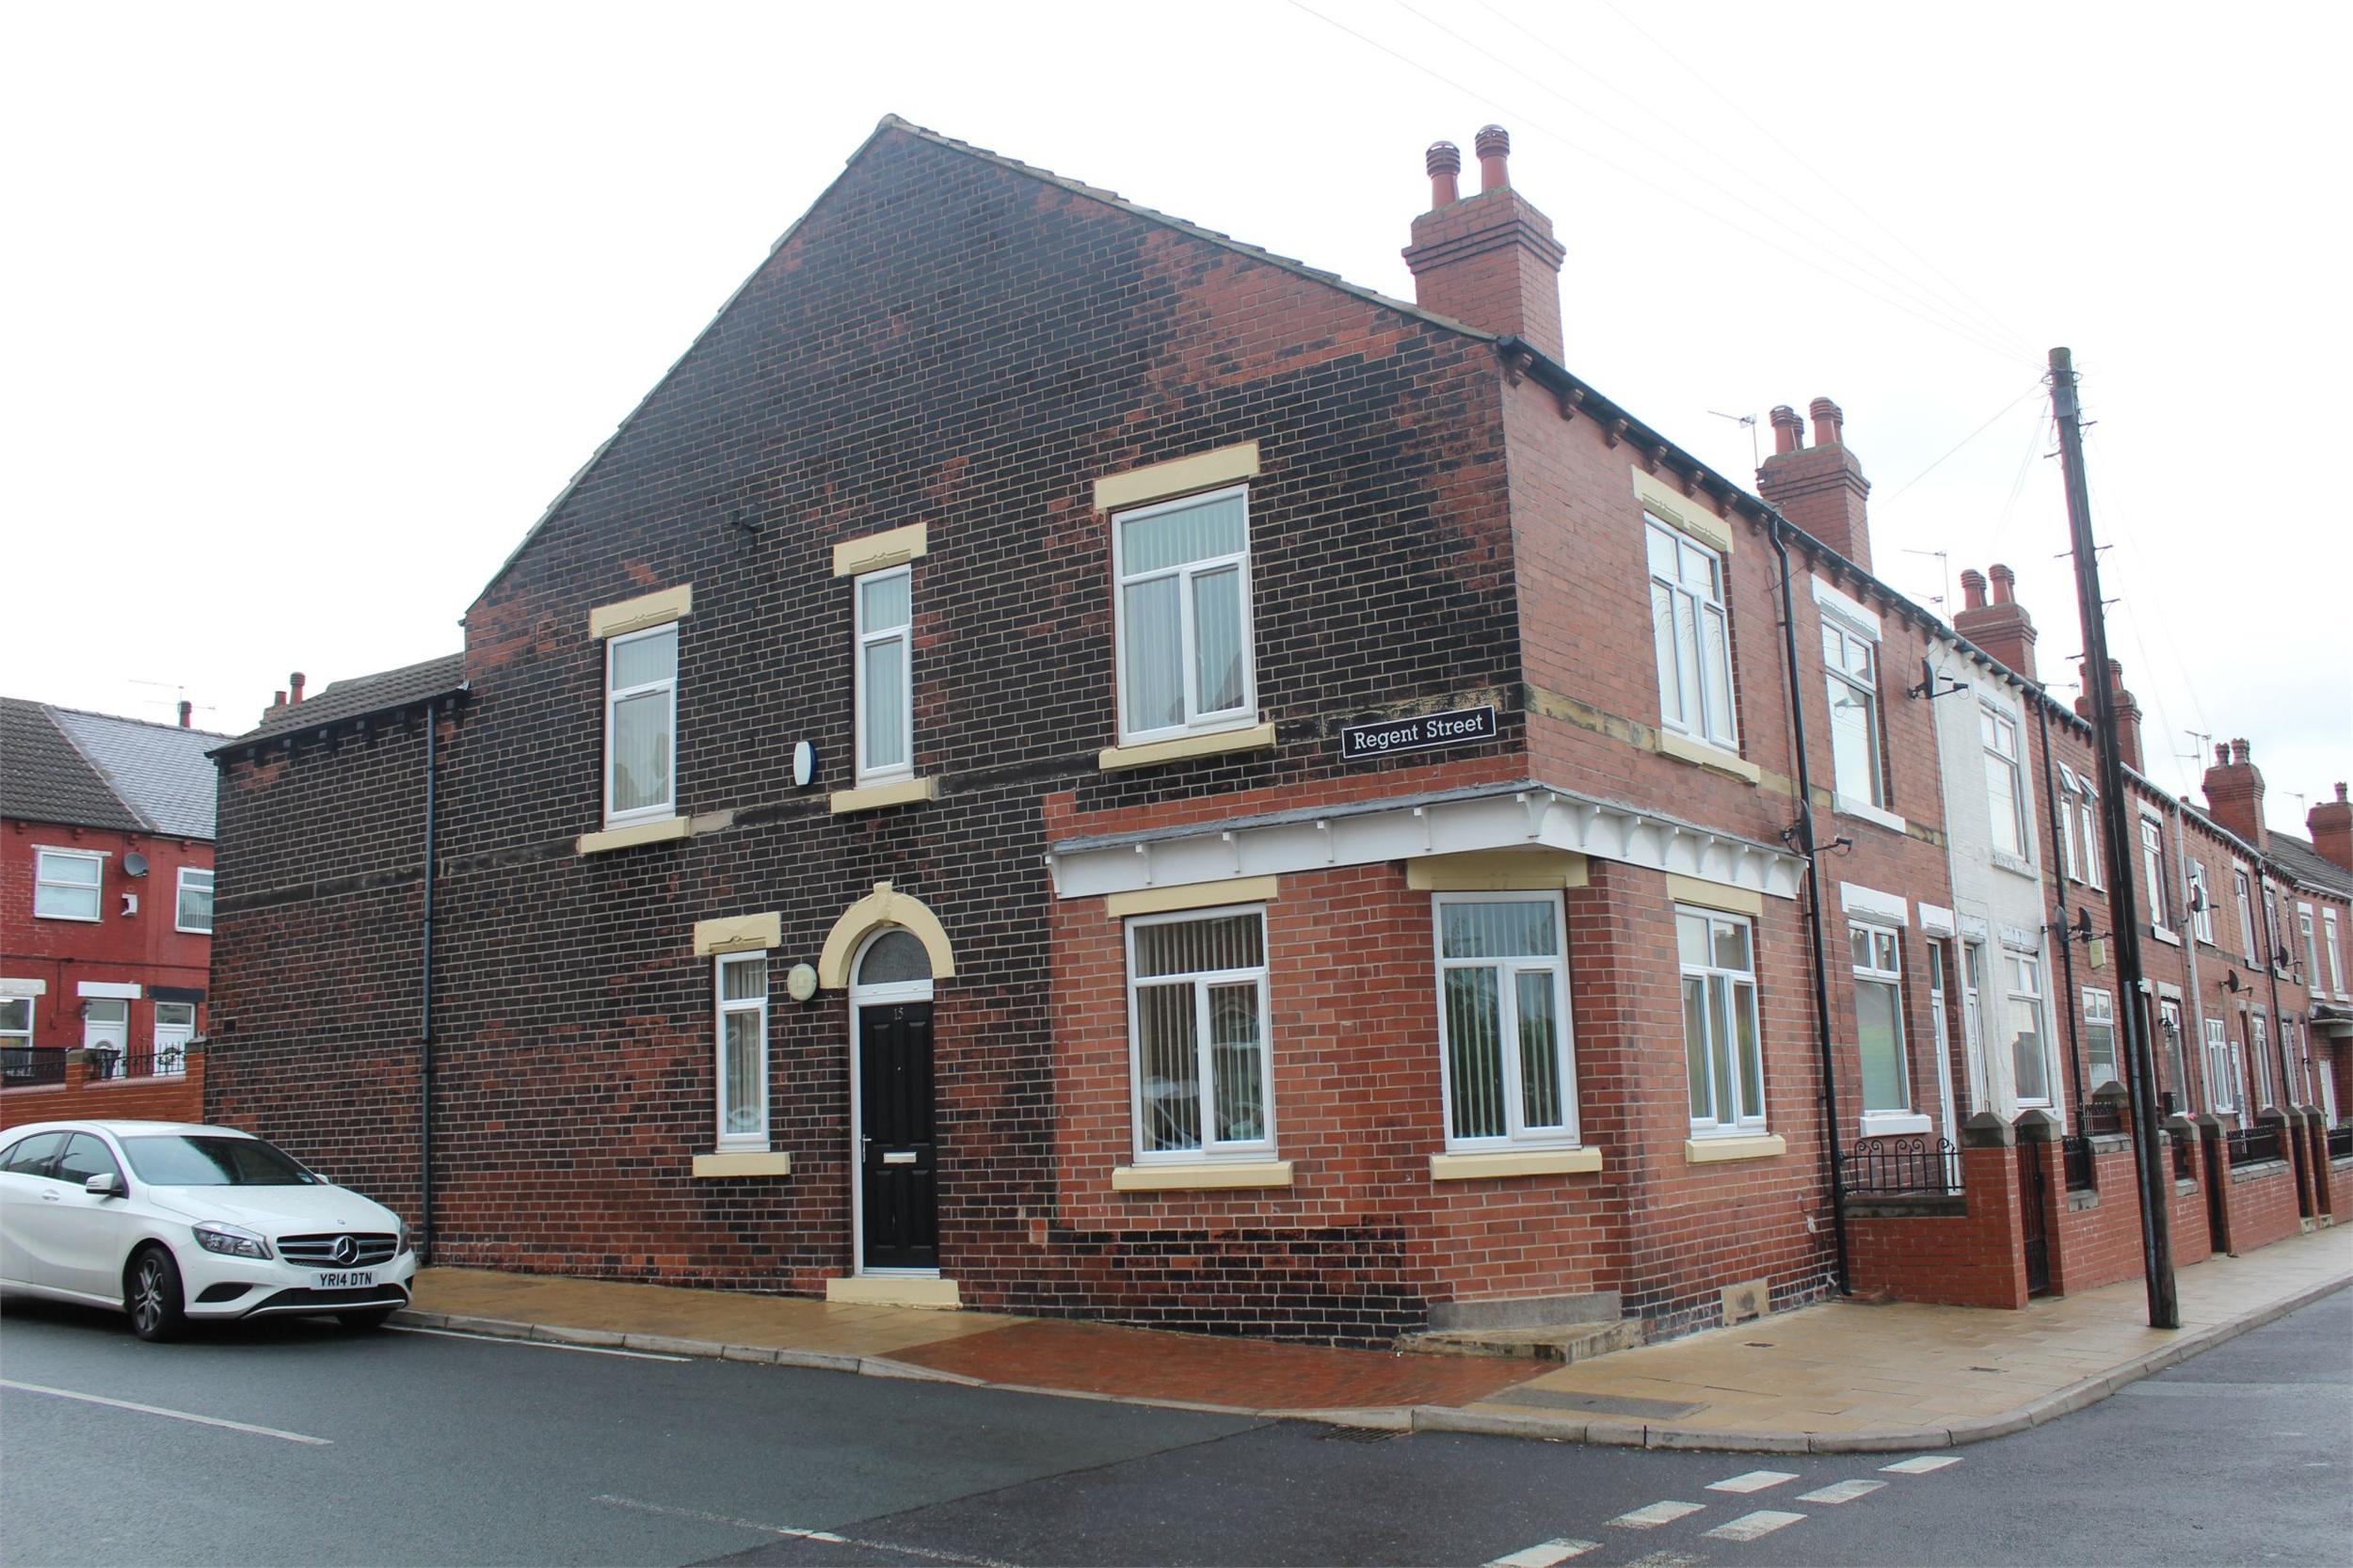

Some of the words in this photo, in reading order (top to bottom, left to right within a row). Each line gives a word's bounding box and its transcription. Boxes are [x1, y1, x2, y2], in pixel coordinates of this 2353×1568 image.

[1353, 725, 1419, 750] Regent
[1426, 713, 1483, 739] Street
[894, 1007, 904, 1020] 15
[320, 1273, 347, 1287] YR14
[350, 1272, 373, 1286] DTN
